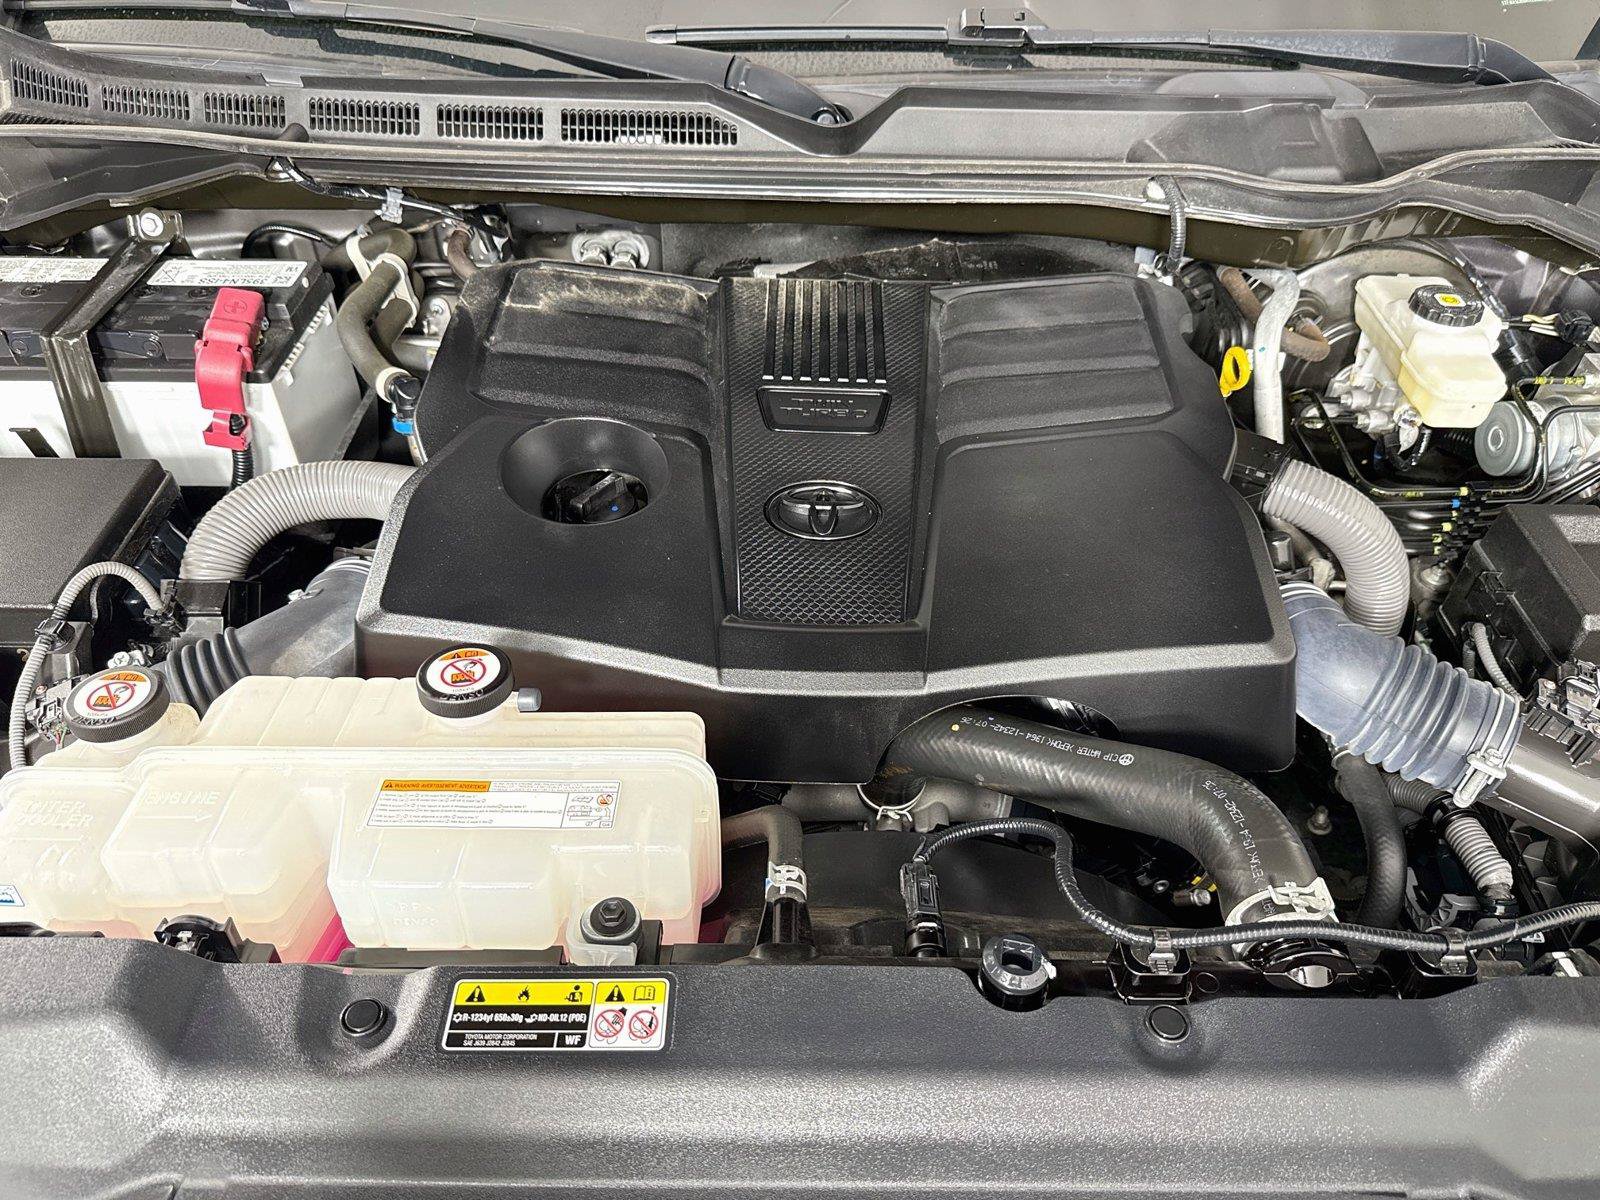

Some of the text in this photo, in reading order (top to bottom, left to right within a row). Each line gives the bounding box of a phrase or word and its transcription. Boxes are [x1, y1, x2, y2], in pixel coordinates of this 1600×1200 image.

[1076, 746, 1102, 758] WATER
[462, 1013, 493, 1024] R-1234yf
[568, 1013, 587, 1023] (POE)
[564, 1035, 582, 1045] WF
